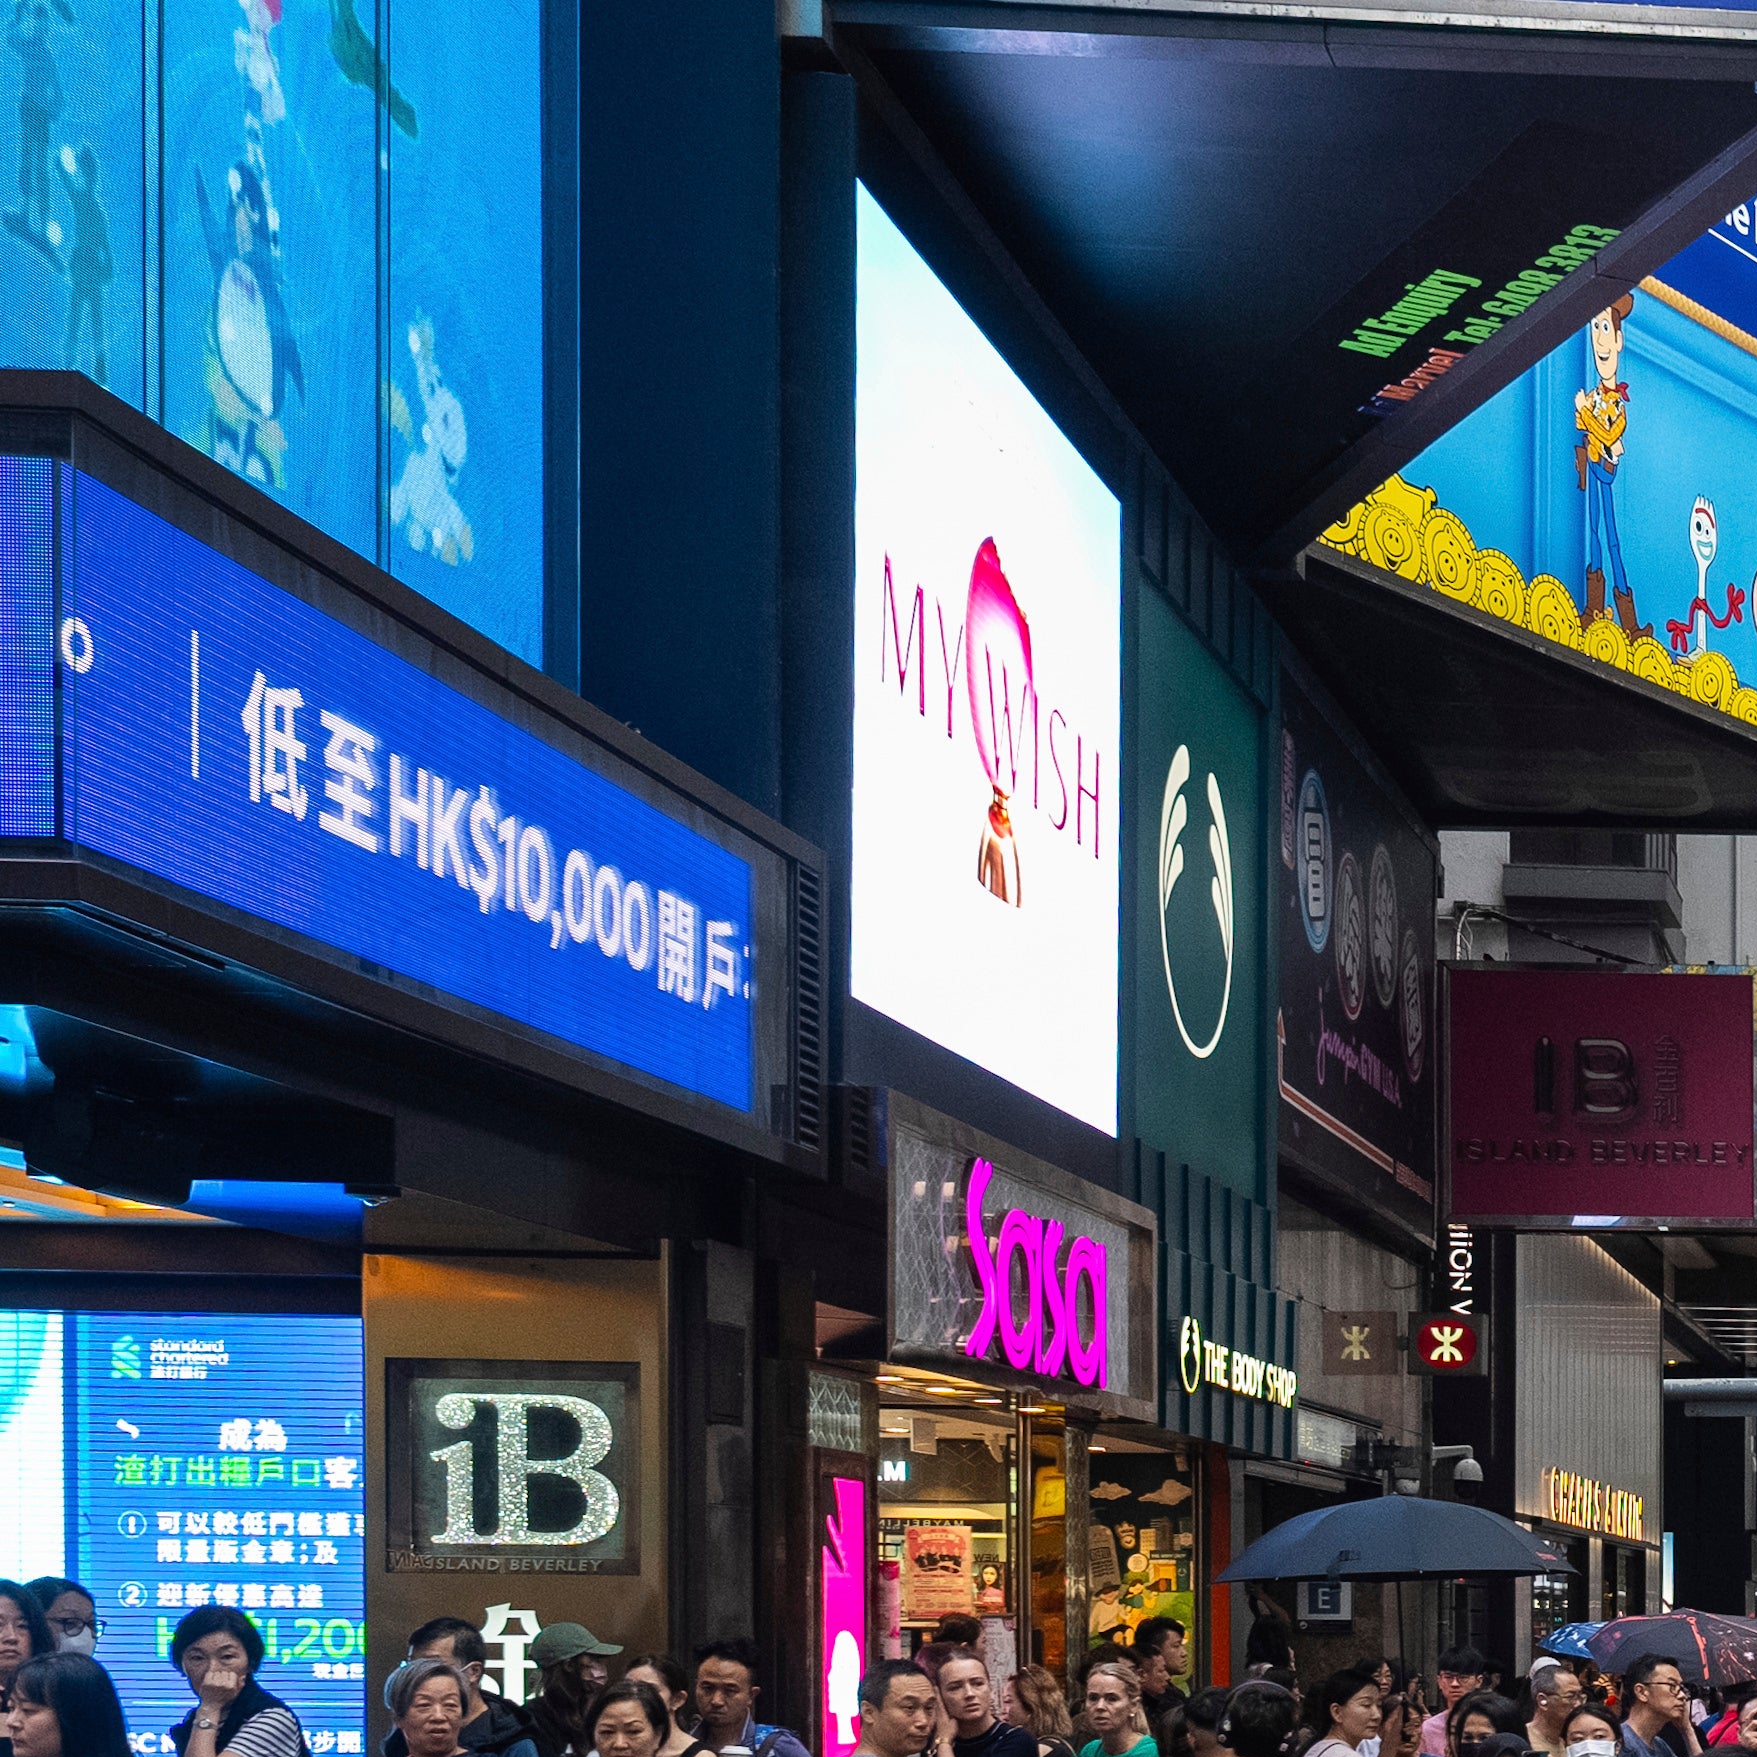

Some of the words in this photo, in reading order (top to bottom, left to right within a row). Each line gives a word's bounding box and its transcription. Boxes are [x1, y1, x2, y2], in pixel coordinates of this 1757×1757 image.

[1362, 268, 1483, 336] Enquiry
[1338, 328, 1407, 359] Ad
[882, 549, 964, 738] MY
[984, 640, 1101, 859] WISH
[1456, 1138, 1577, 1164] ISLAND
[1591, 1139, 1749, 1165] BEVERLEY
[1204, 1340, 1229, 1388] THE
[1232, 1348, 1266, 1400] BODY
[1266, 1361, 1297, 1409] SHOP
[218, 1417, 289, 1451] 成為
[113, 1453, 365, 1490] 渣打出糧戶口客
[509, 1557, 603, 1573] BEVERLEY
